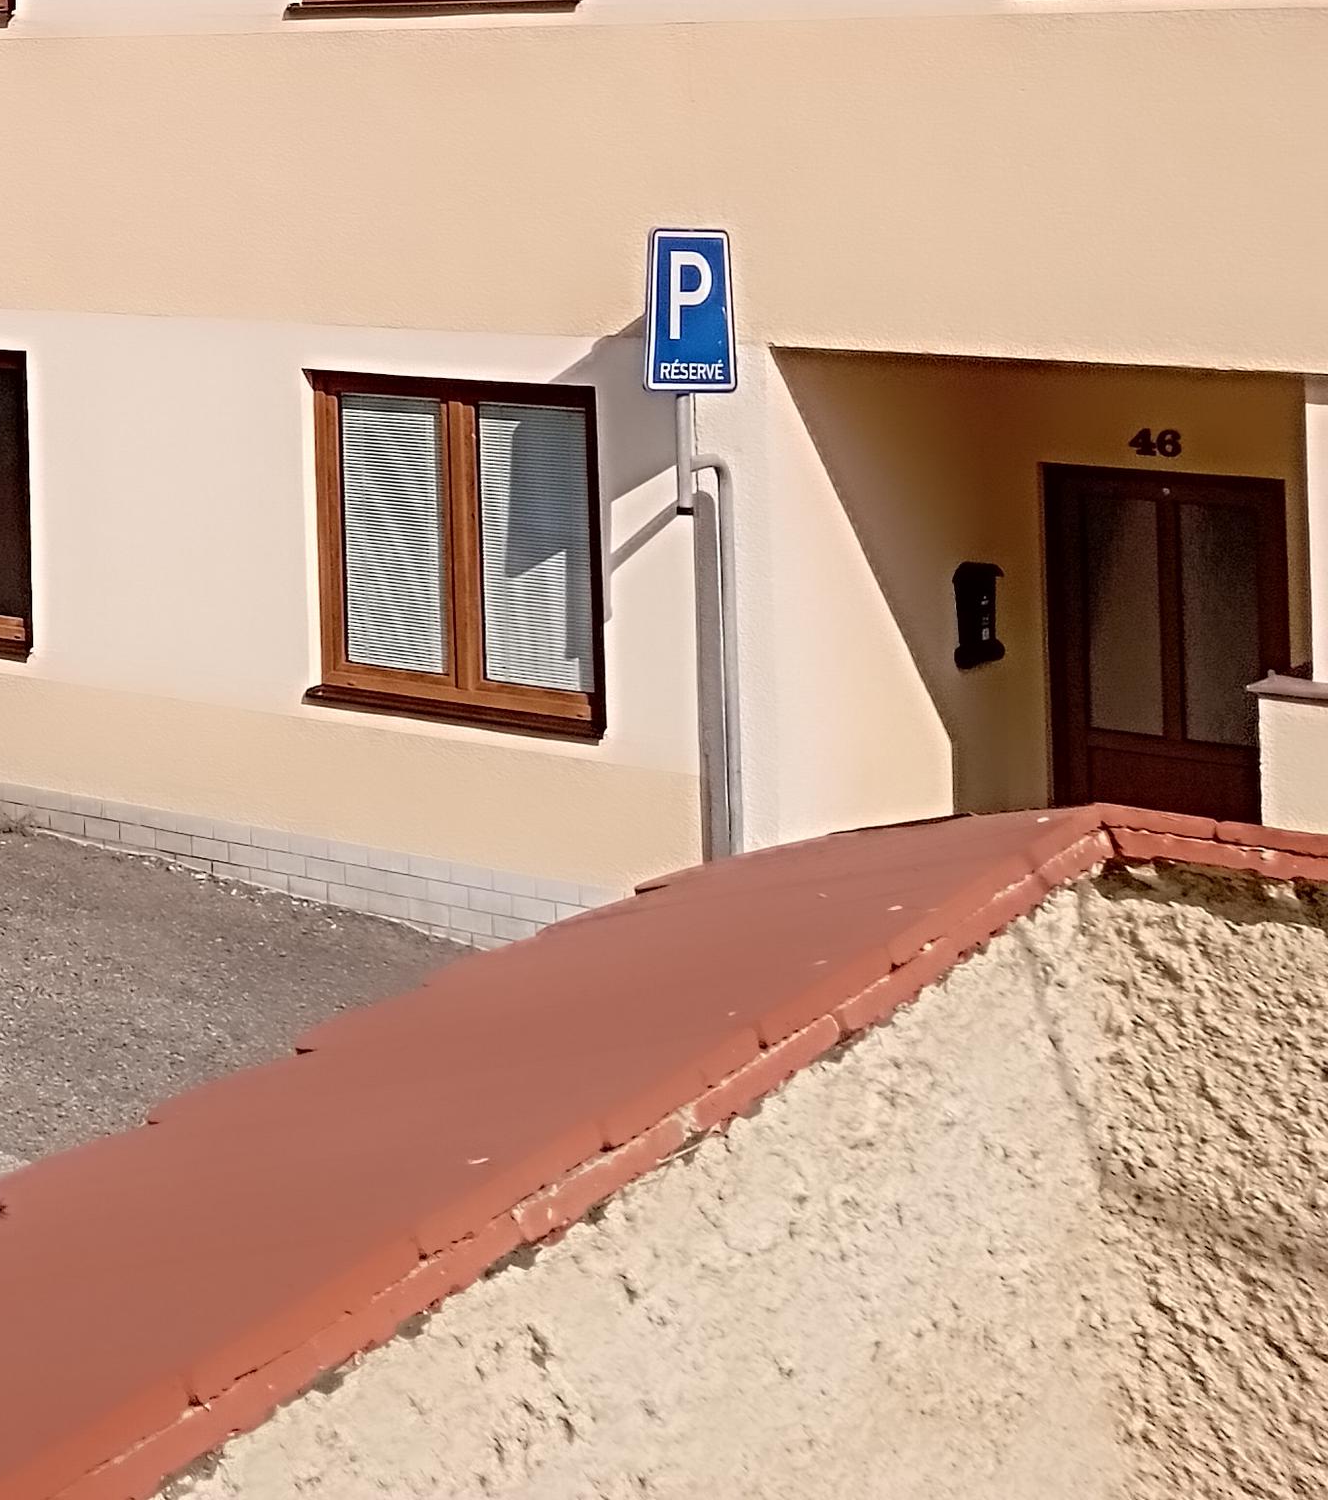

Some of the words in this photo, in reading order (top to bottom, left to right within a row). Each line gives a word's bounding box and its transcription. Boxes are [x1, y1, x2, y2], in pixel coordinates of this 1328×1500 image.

[669, 250, 714, 340] P
[659, 359, 725, 381] RÉSERVÉ
[1128, 427, 1183, 458] 46
